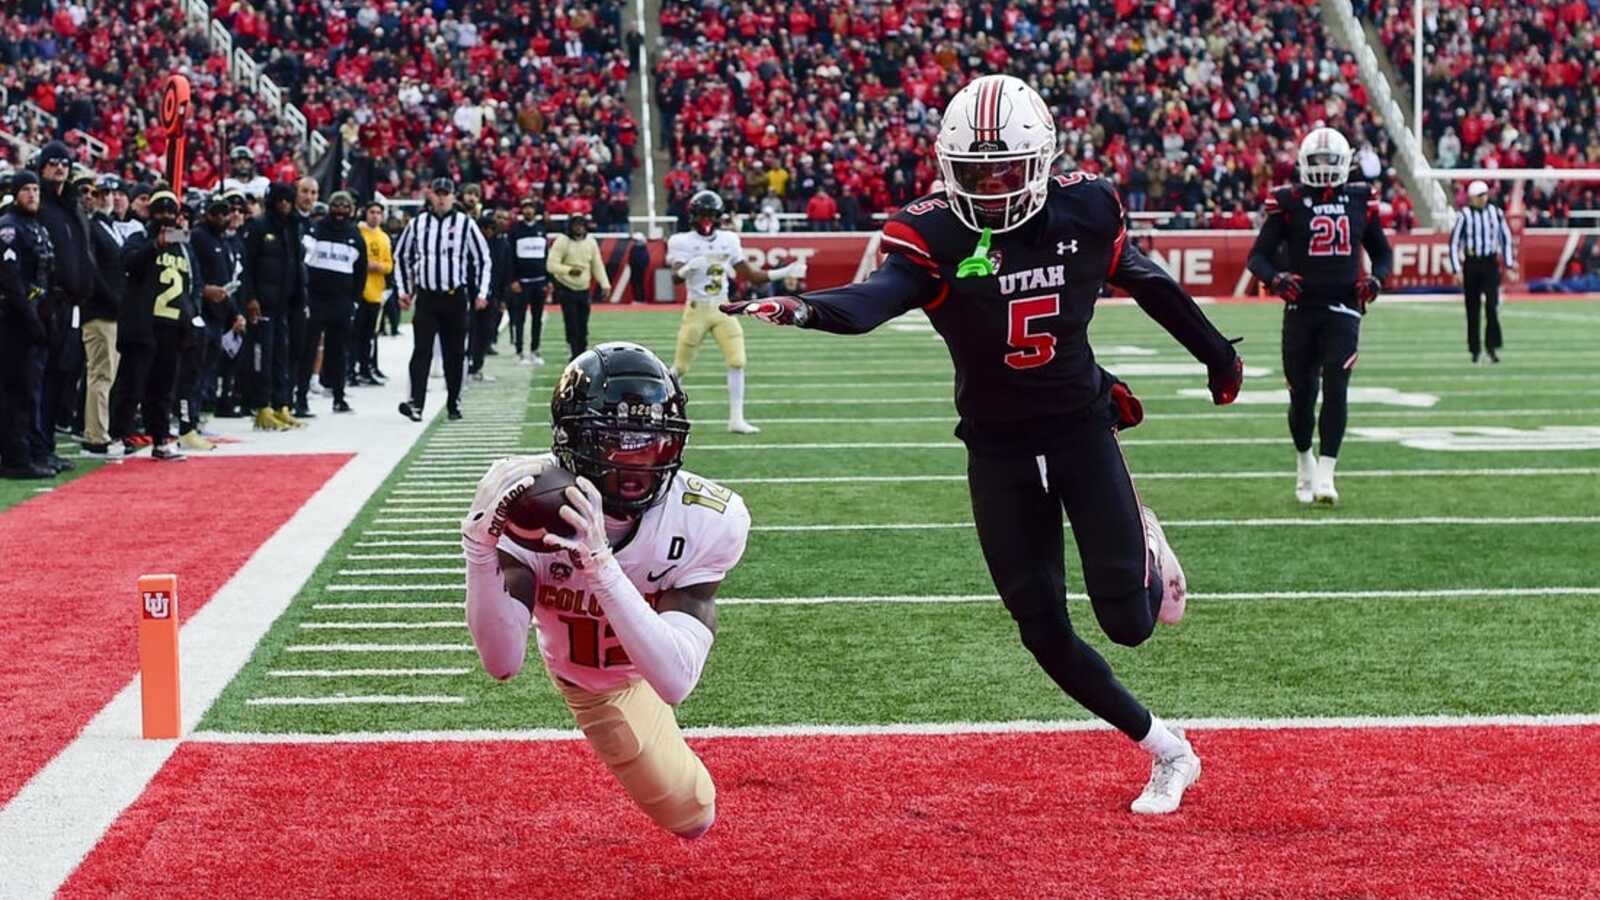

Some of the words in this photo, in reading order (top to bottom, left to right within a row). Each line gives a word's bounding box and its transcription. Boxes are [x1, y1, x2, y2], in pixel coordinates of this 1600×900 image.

[907, 198, 949, 216] 5
[1312, 203, 1346, 215] UTAH
[1308, 215, 1352, 256] 21
[1147, 248, 1215, 285] NE
[1392, 242, 1454, 277] FIR
[152, 267, 184, 320] 2
[704, 263, 725, 295] 3
[998, 264, 1066, 295] UTAH
[1004, 293, 1060, 370] 5
[682, 477, 733, 514] 12
[667, 536, 686, 561] D
